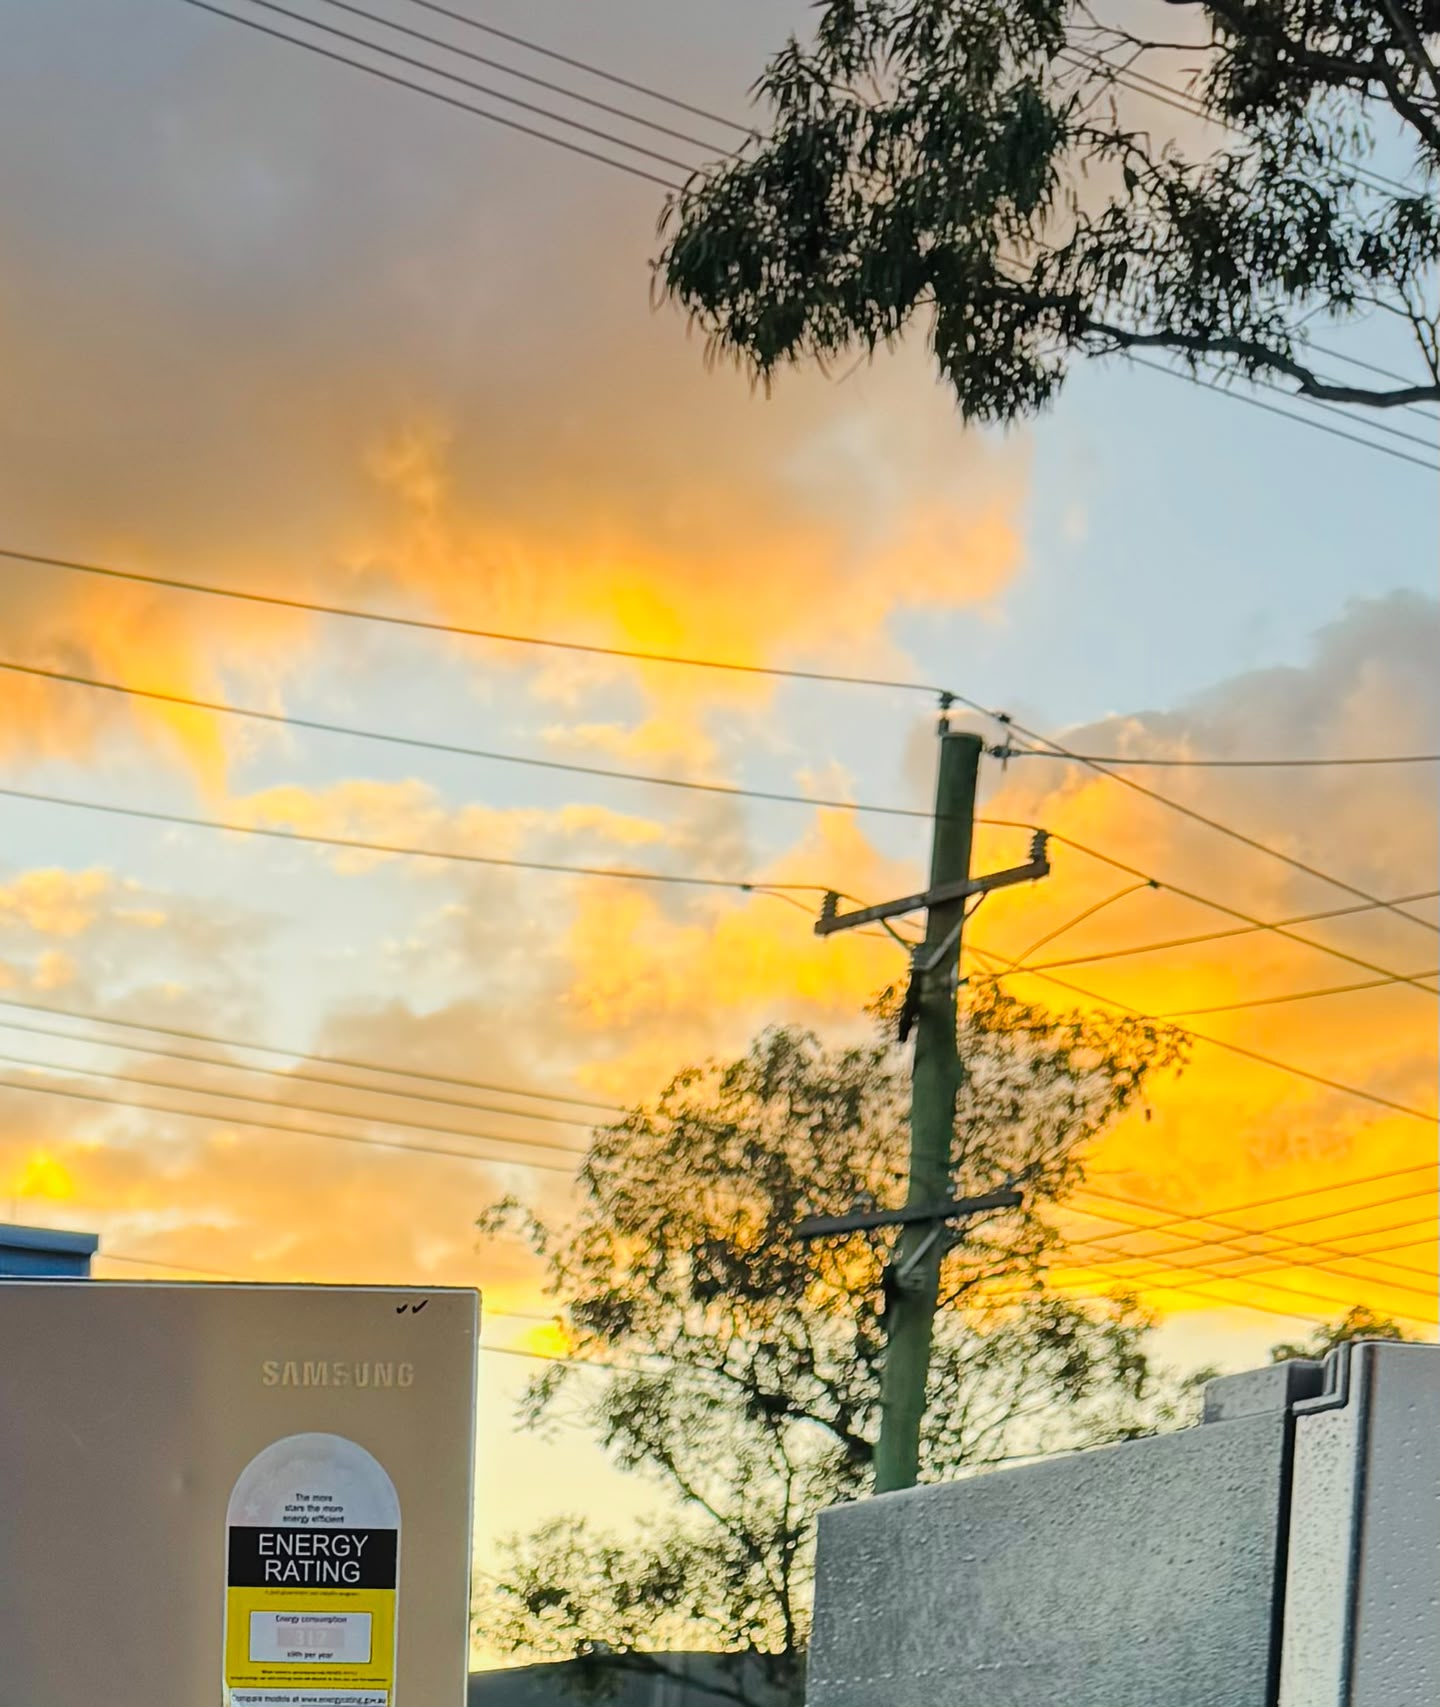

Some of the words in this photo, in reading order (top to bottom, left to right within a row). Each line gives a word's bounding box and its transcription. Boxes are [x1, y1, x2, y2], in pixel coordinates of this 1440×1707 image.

[262, 1361, 414, 1387] SAMSUNG
[258, 1533, 369, 1557] ENERGY
[265, 1560, 361, 1583] RATING
